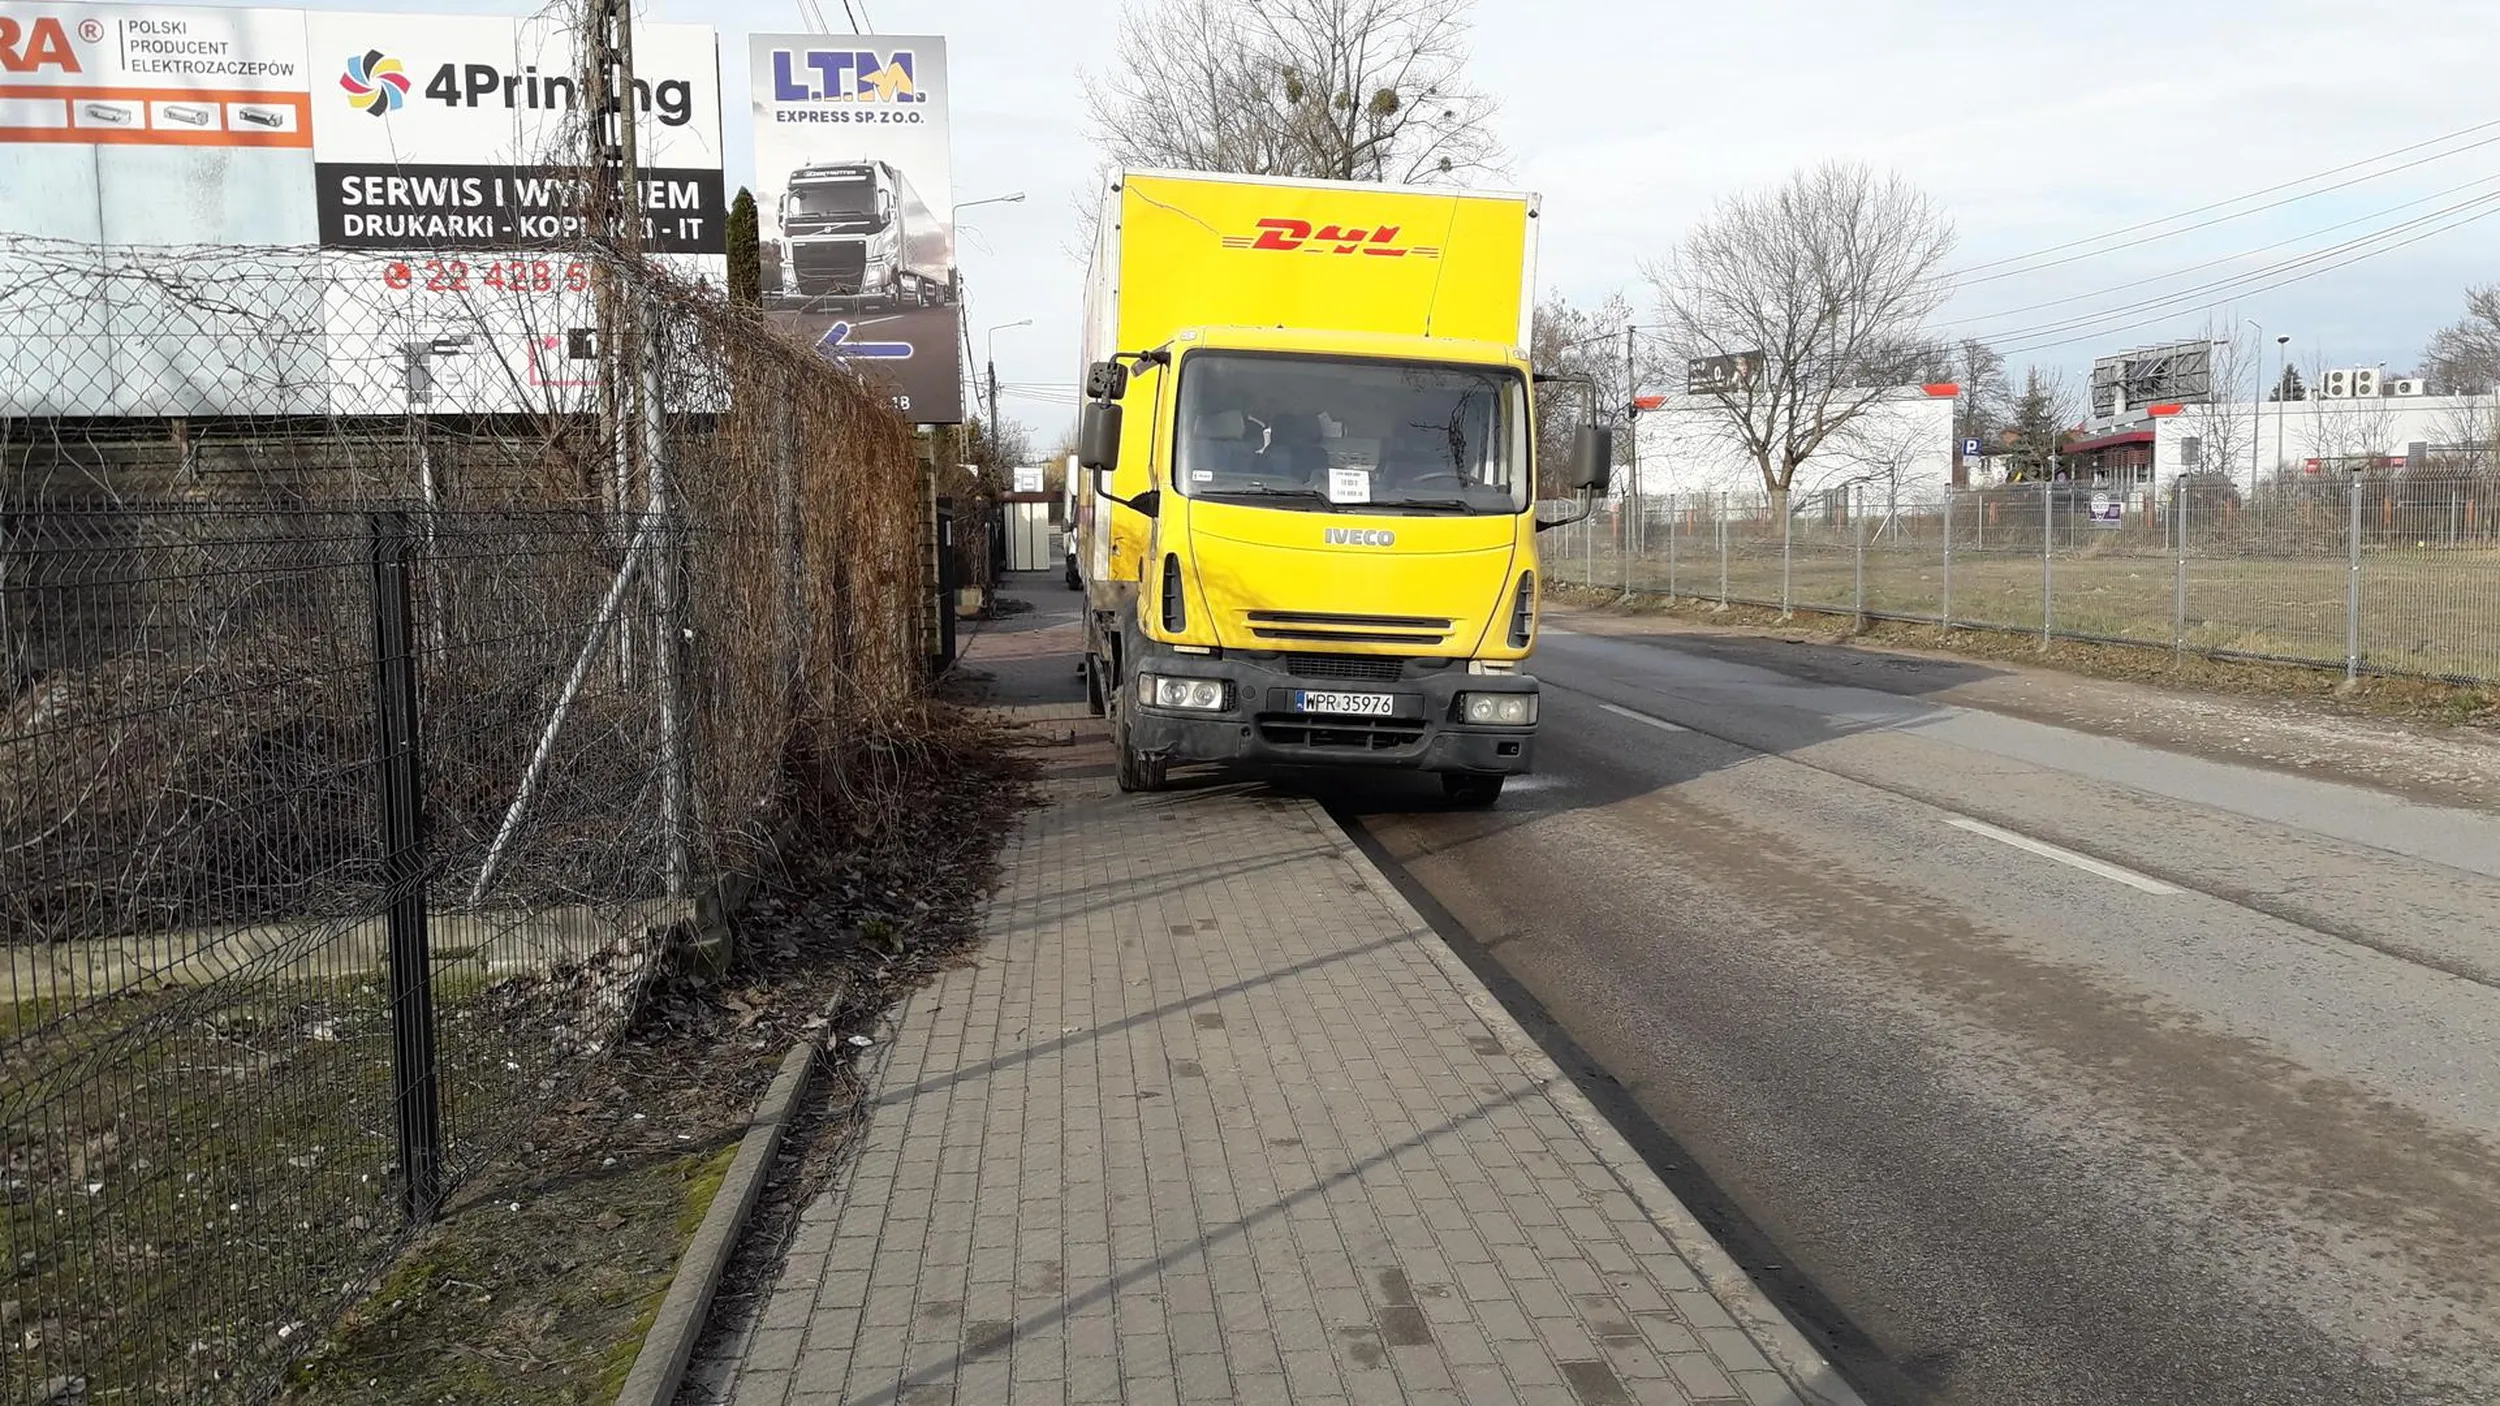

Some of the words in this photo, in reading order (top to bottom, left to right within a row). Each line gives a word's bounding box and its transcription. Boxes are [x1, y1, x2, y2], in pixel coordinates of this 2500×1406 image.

[128, 20, 187, 35] POLSKI
[130, 40, 229, 55] PRODUCENT
[131, 58, 294, 77] ELEKTROZACZEPÓW
[425, 63, 691, 127] 4Prinng
[776, 110, 850, 123] EXPRESS
[855, 111, 877, 123] SP.
[341, 175, 483, 207] SERWIS
[495, 178, 504, 207] I
[515, 178, 700, 213] WYJEM
[344, 214, 494, 238] DRUKARKI
[678, 218, 703, 240] IT
[1253, 218, 1408, 257] DHL
[425, 259, 471, 292] 22
[483, 260, 550, 292] 428
[1325, 528, 1395, 547] IVECO
[1306, 693, 1337, 711] WPR
[1342, 695, 1391, 713] 35976
